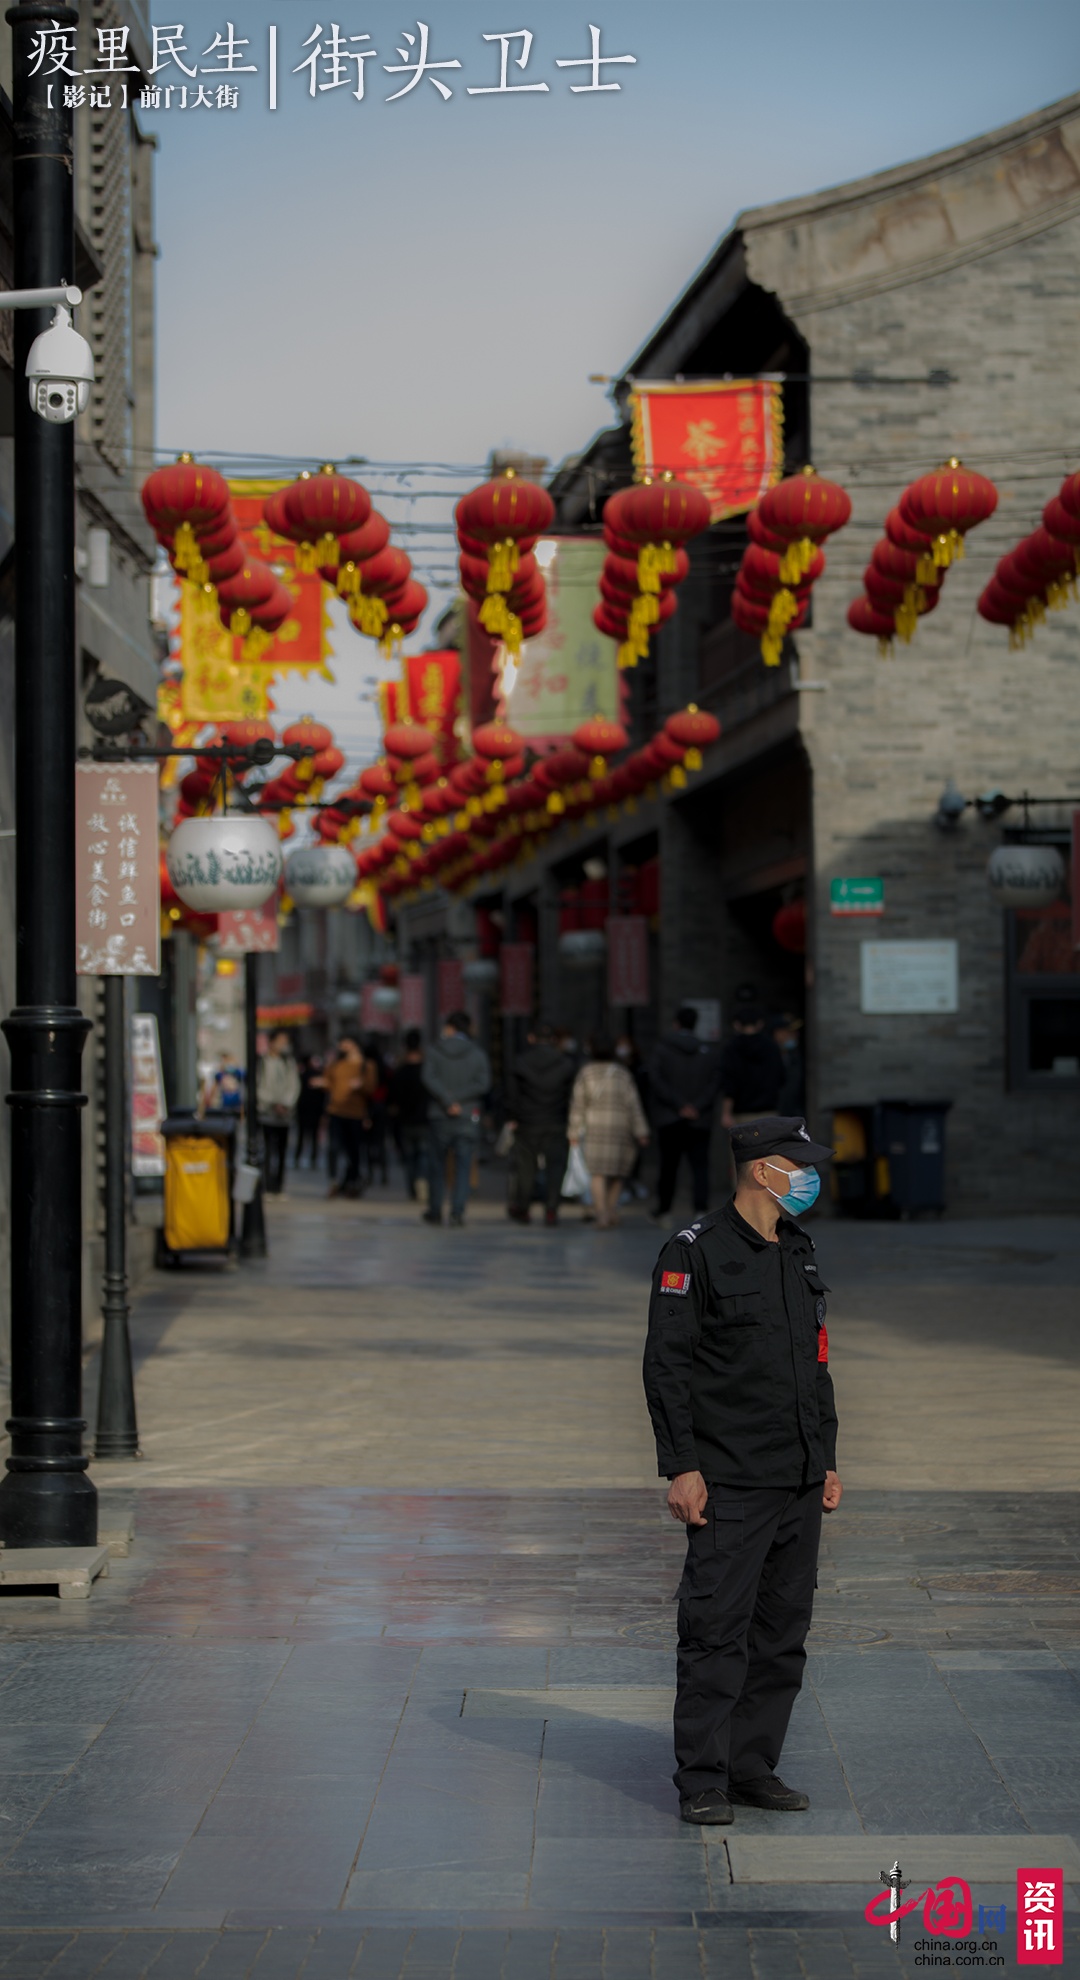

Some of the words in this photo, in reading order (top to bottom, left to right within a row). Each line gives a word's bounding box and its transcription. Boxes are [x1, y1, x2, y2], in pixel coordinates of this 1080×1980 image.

[86, 812, 111, 931] 放心美食街
